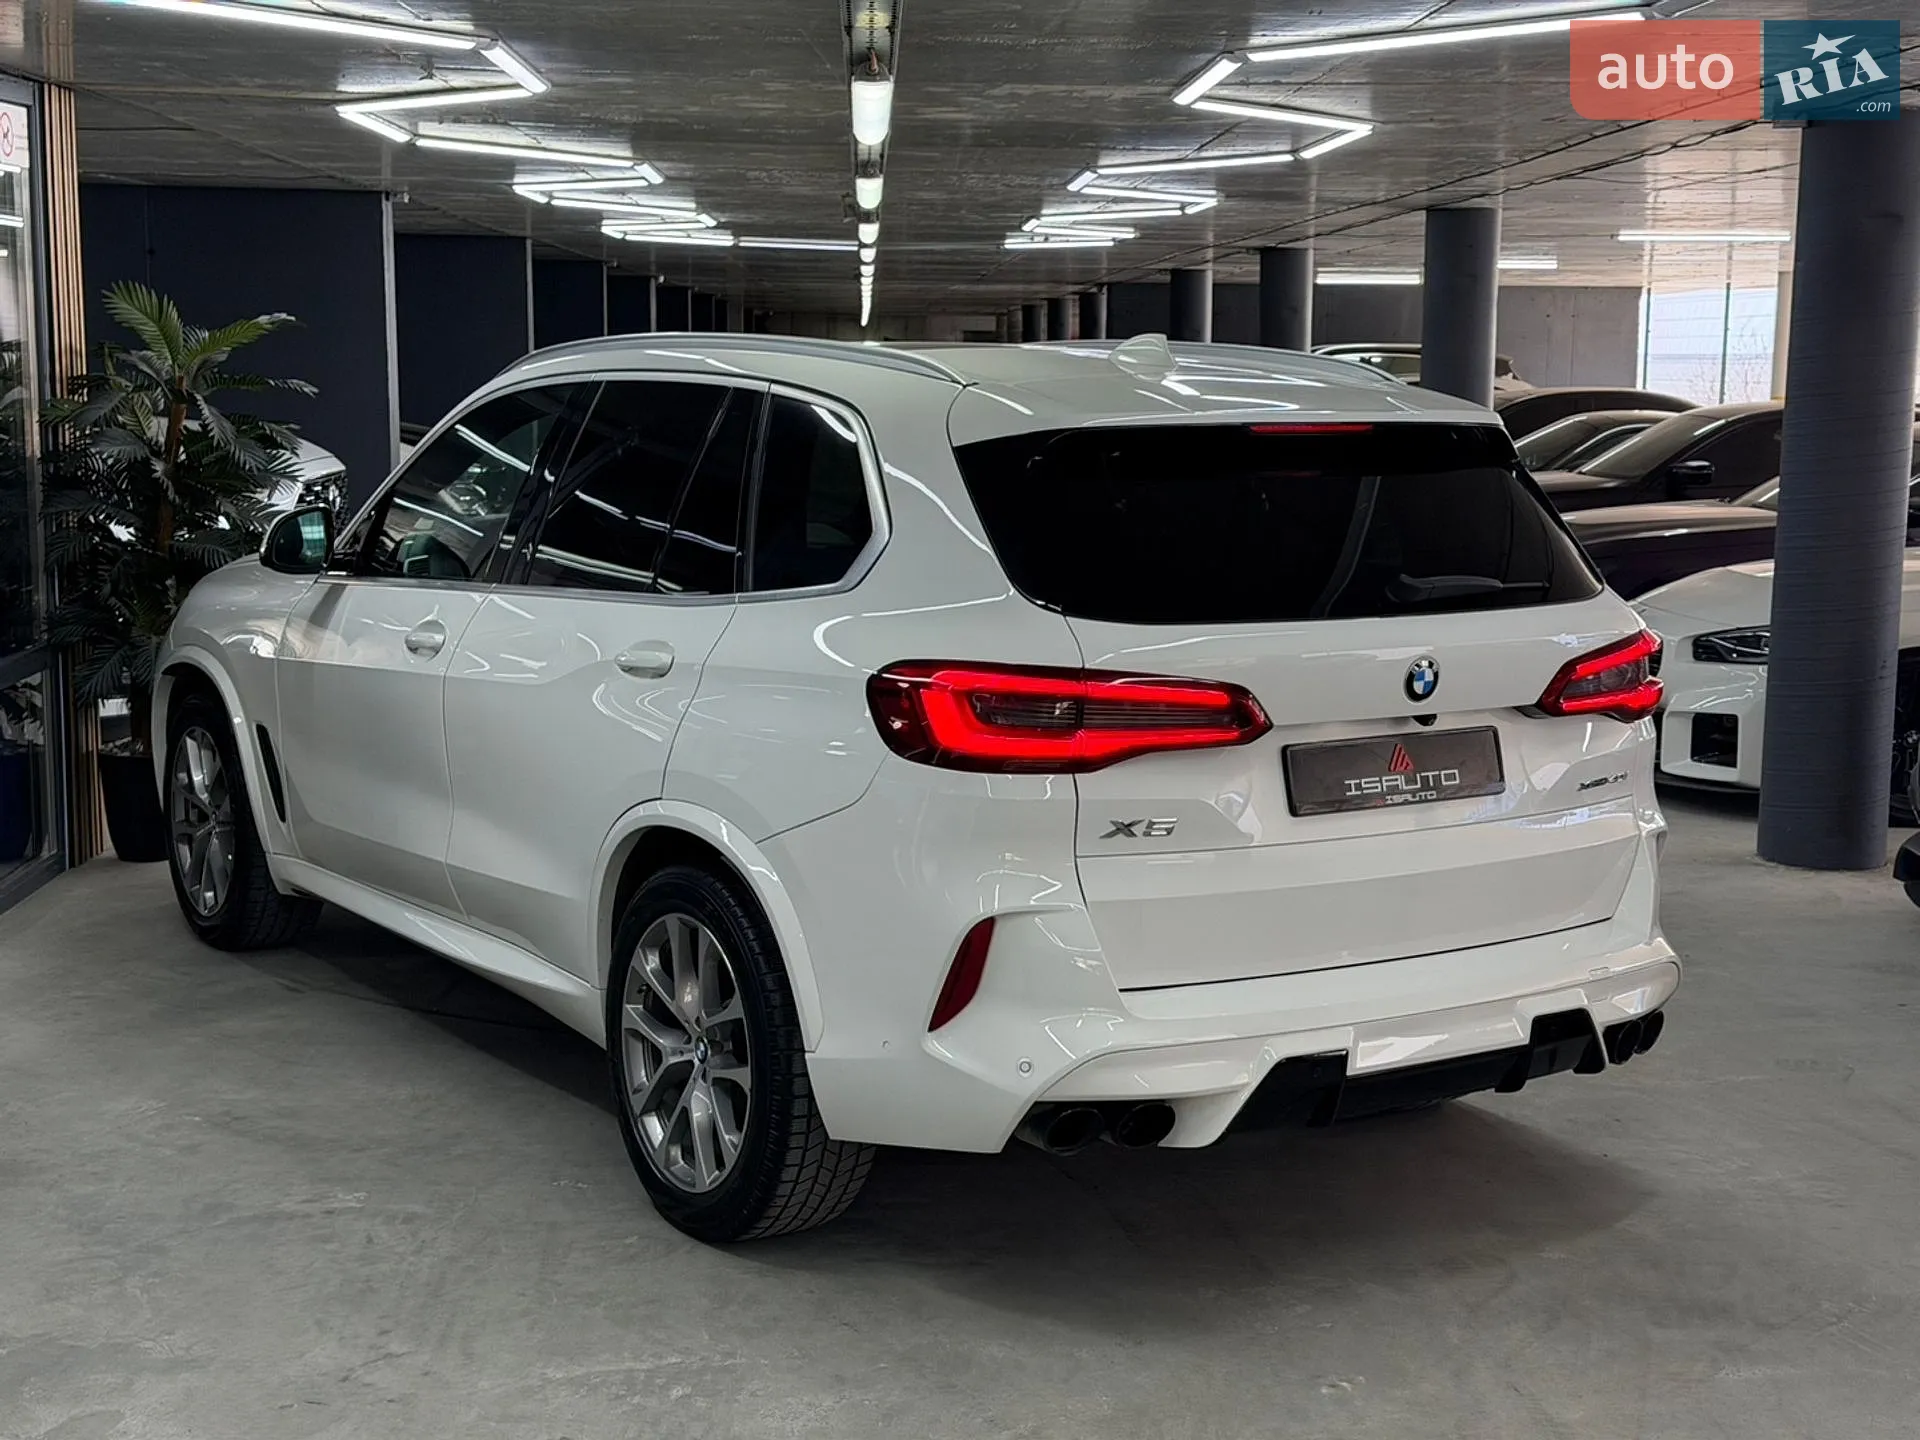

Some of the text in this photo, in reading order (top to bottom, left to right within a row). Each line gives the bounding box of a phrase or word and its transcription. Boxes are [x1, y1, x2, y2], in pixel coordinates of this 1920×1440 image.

[1344, 769, 1460, 796] ISAUTO
[1385, 790, 1437, 804] ISAUTO
[1099, 817, 1178, 839] X5
